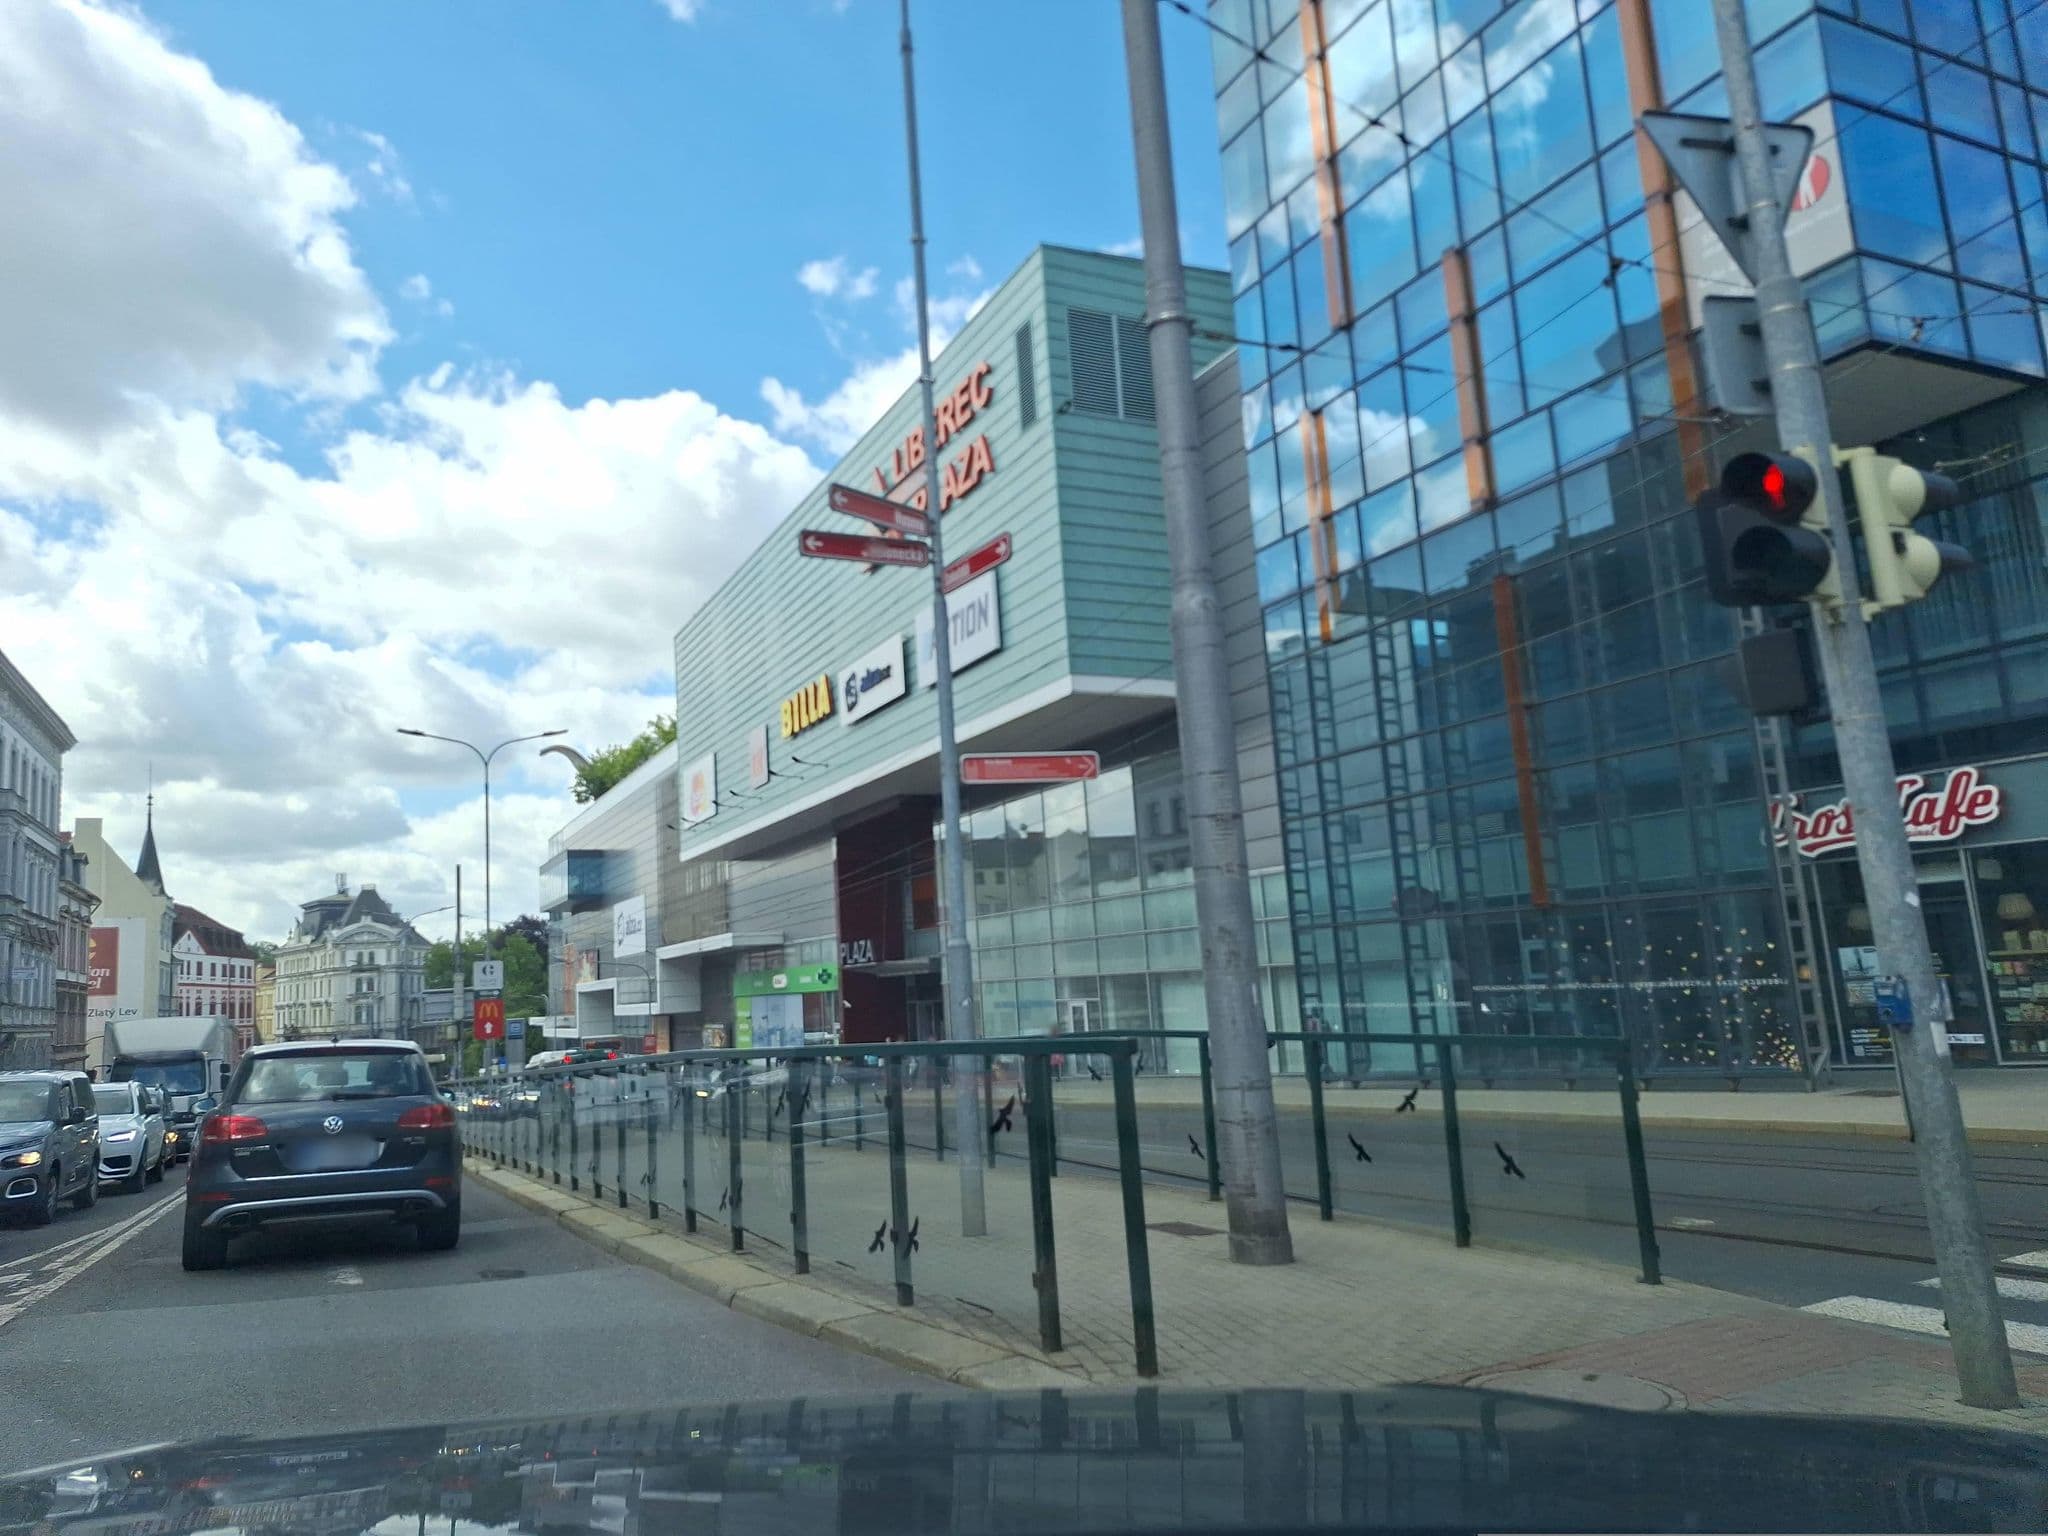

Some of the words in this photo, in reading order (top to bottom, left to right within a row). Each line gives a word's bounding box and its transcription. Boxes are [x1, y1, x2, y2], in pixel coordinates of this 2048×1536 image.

[891, 360, 994, 484] LIBREC
[783, 672, 832, 738] BILLA
[840, 939, 874, 964] PLAZA
[118, 1007, 138, 1017] Lev
